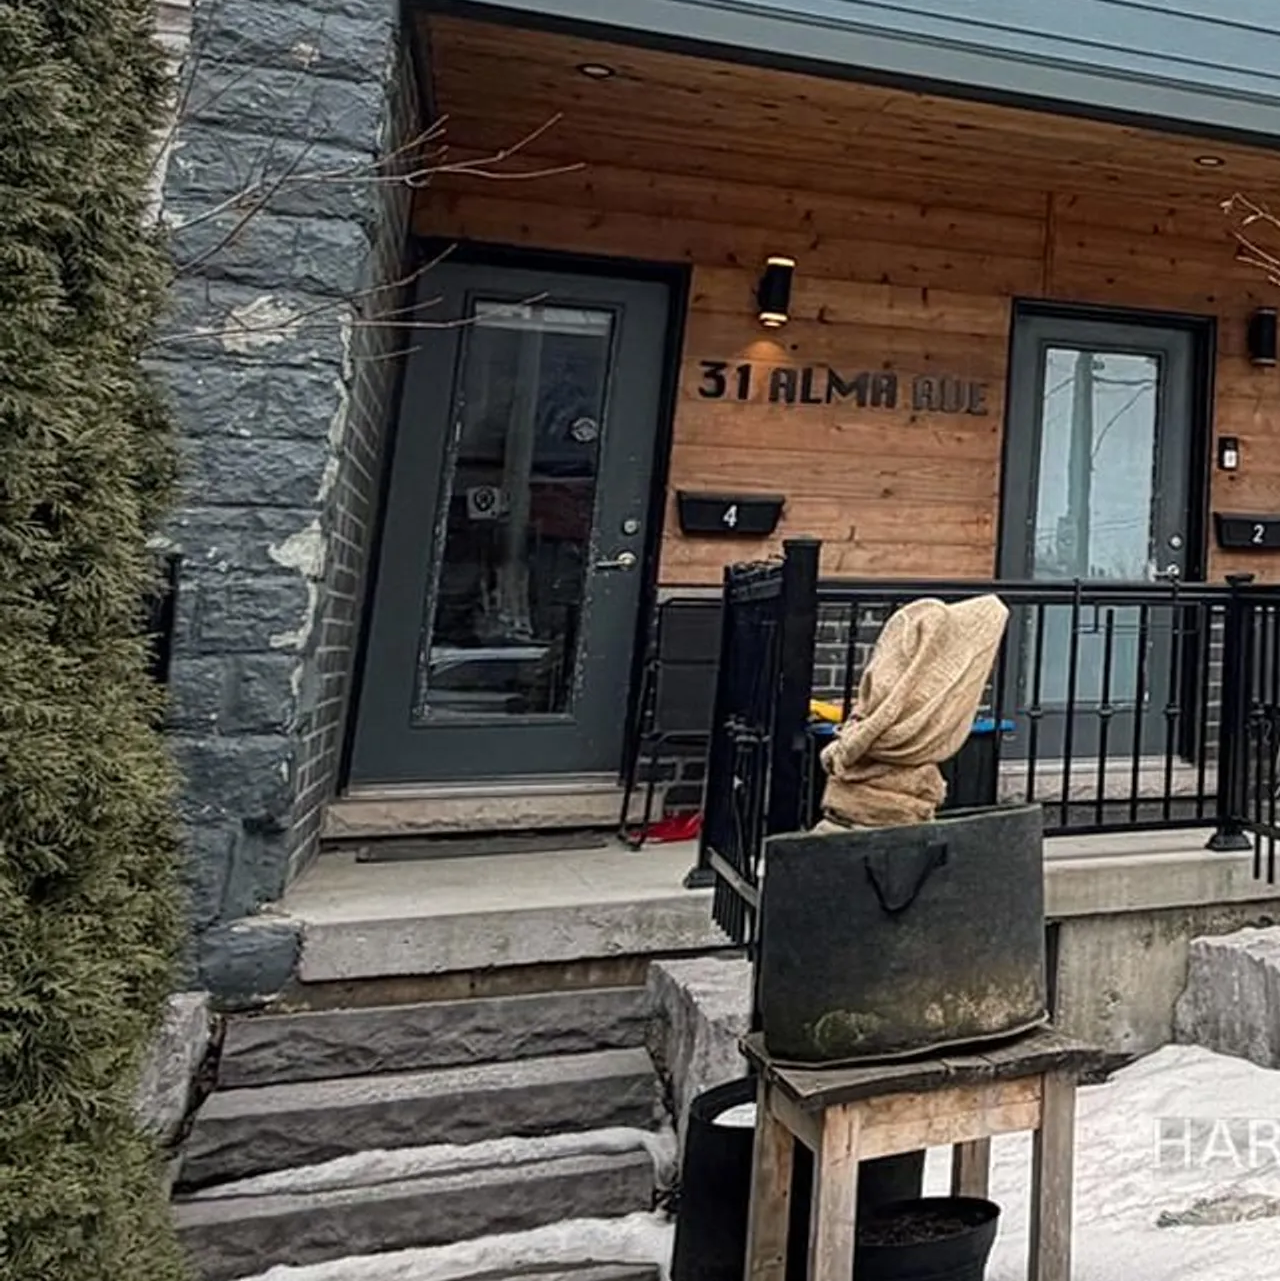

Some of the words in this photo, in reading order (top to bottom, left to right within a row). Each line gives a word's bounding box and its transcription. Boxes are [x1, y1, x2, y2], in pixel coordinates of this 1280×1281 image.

[699, 360, 752, 401] 31
[769, 365, 898, 409] ALMA
[722, 504, 738, 528] 4
[1252, 523, 1265, 545] 2
